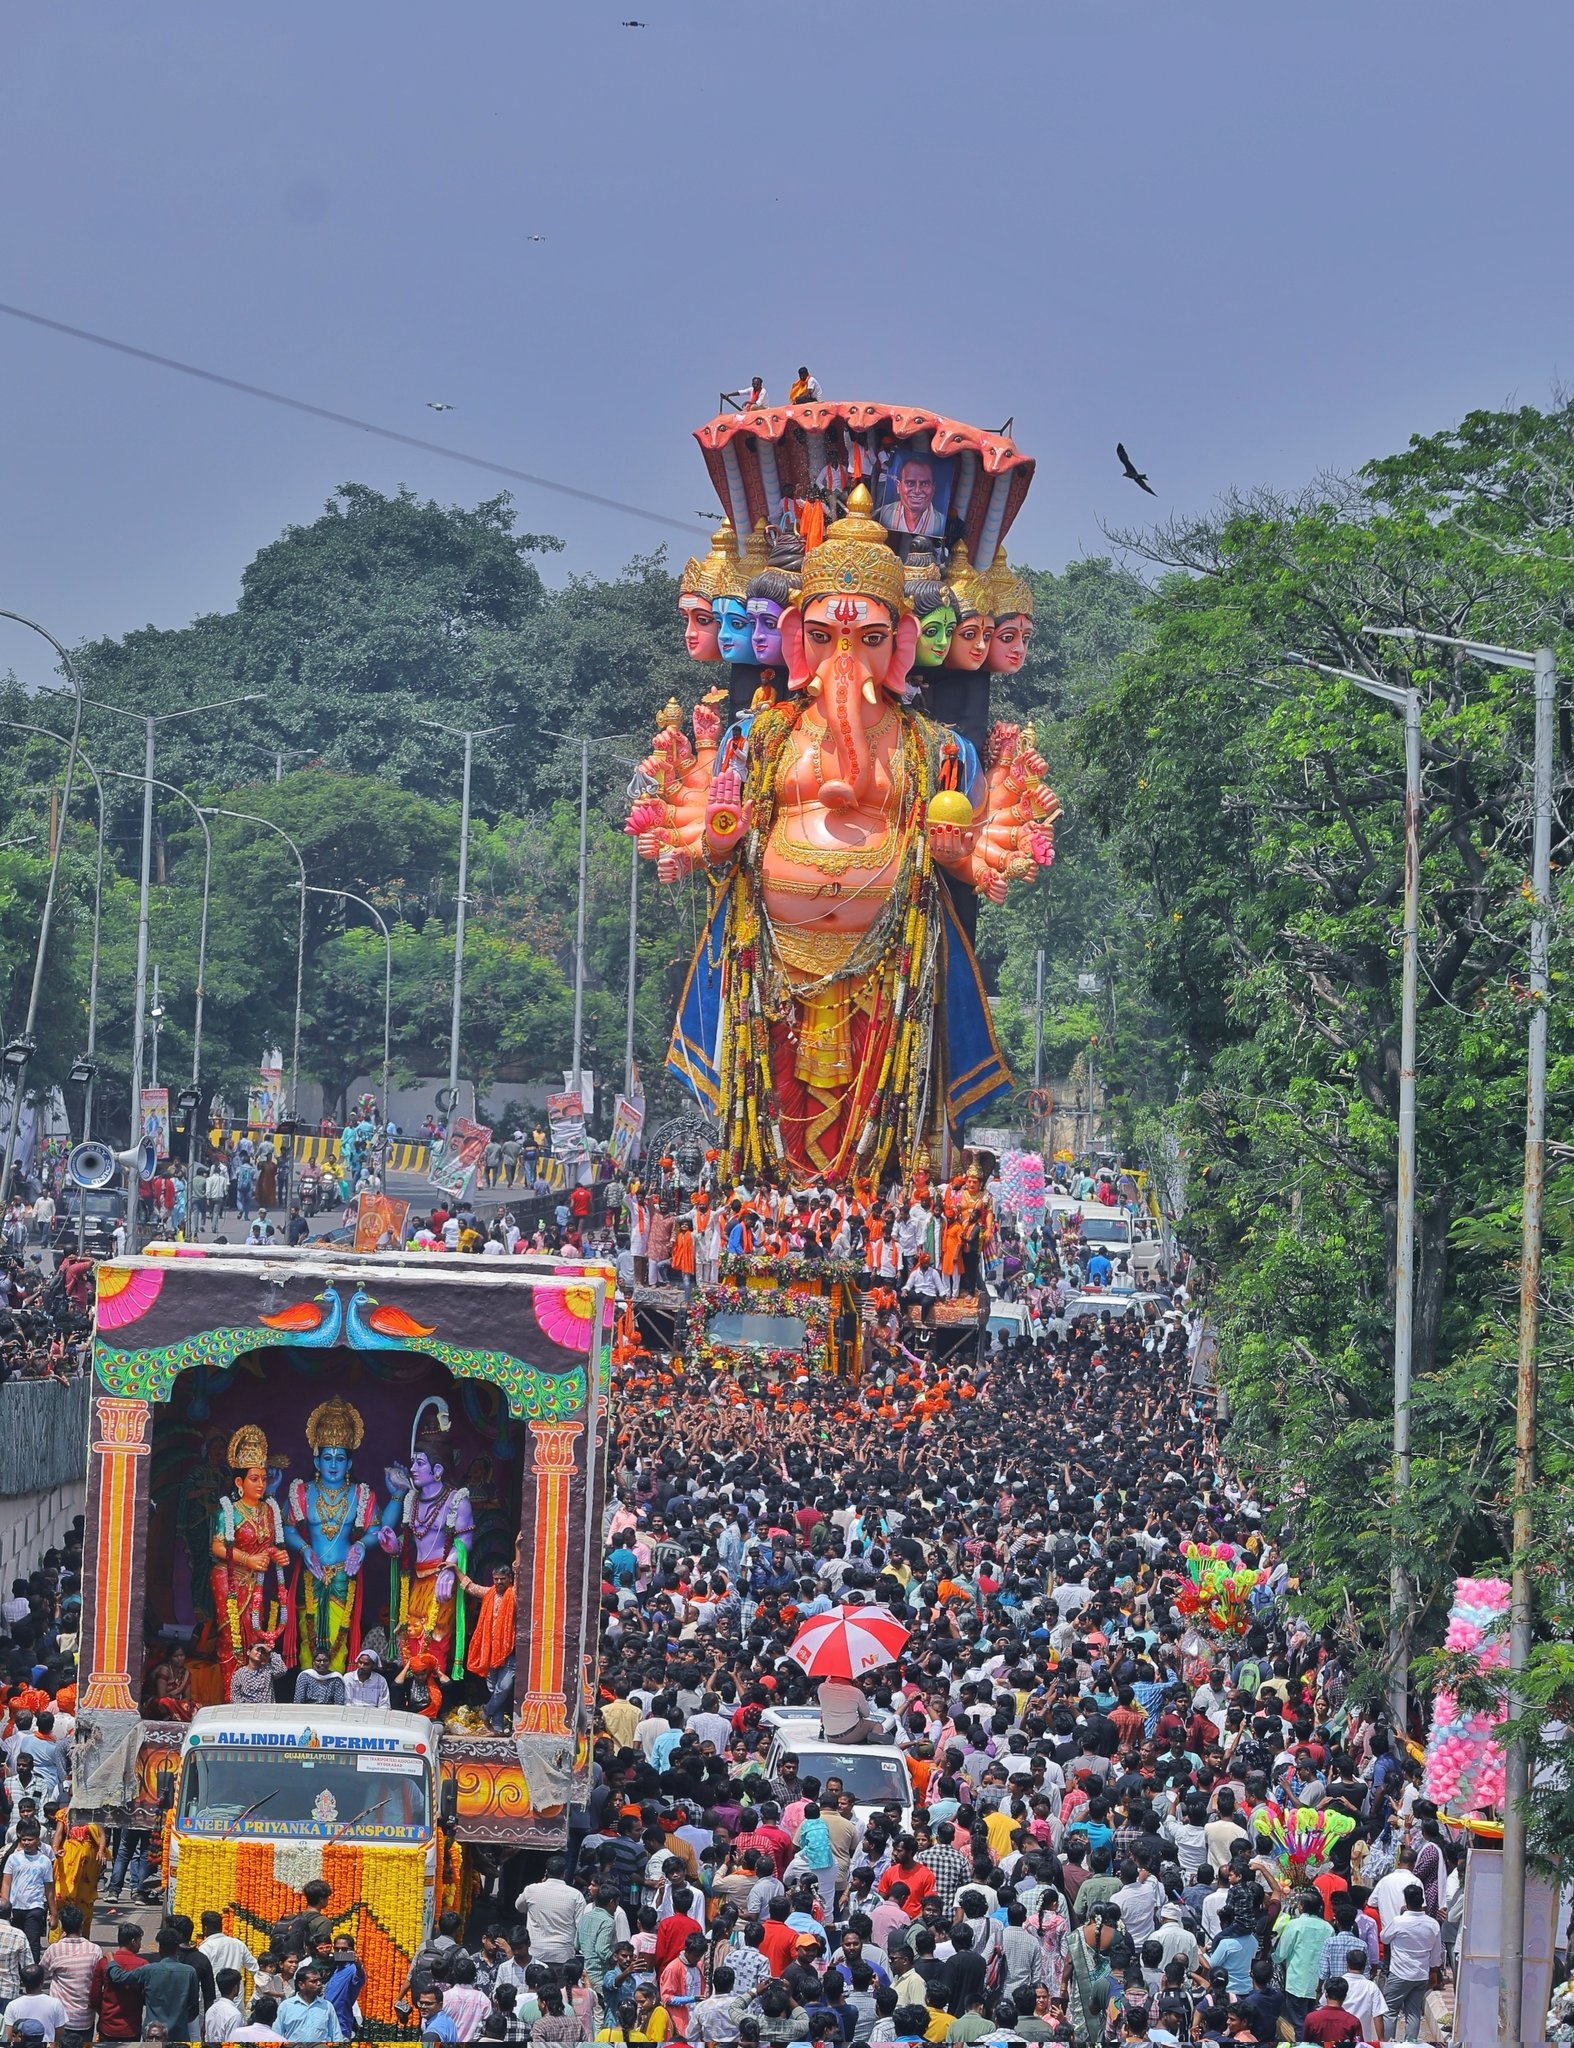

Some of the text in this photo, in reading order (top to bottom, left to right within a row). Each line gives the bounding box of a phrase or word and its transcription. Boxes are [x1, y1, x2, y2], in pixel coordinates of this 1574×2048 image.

[218, 1732, 399, 1750] ALL INDIA PERMIT
[284, 1752, 335, 1761] GUJJARLAPUDI
[195, 1819, 415, 1838] NEELA PRIYANKA TRANSPORT
